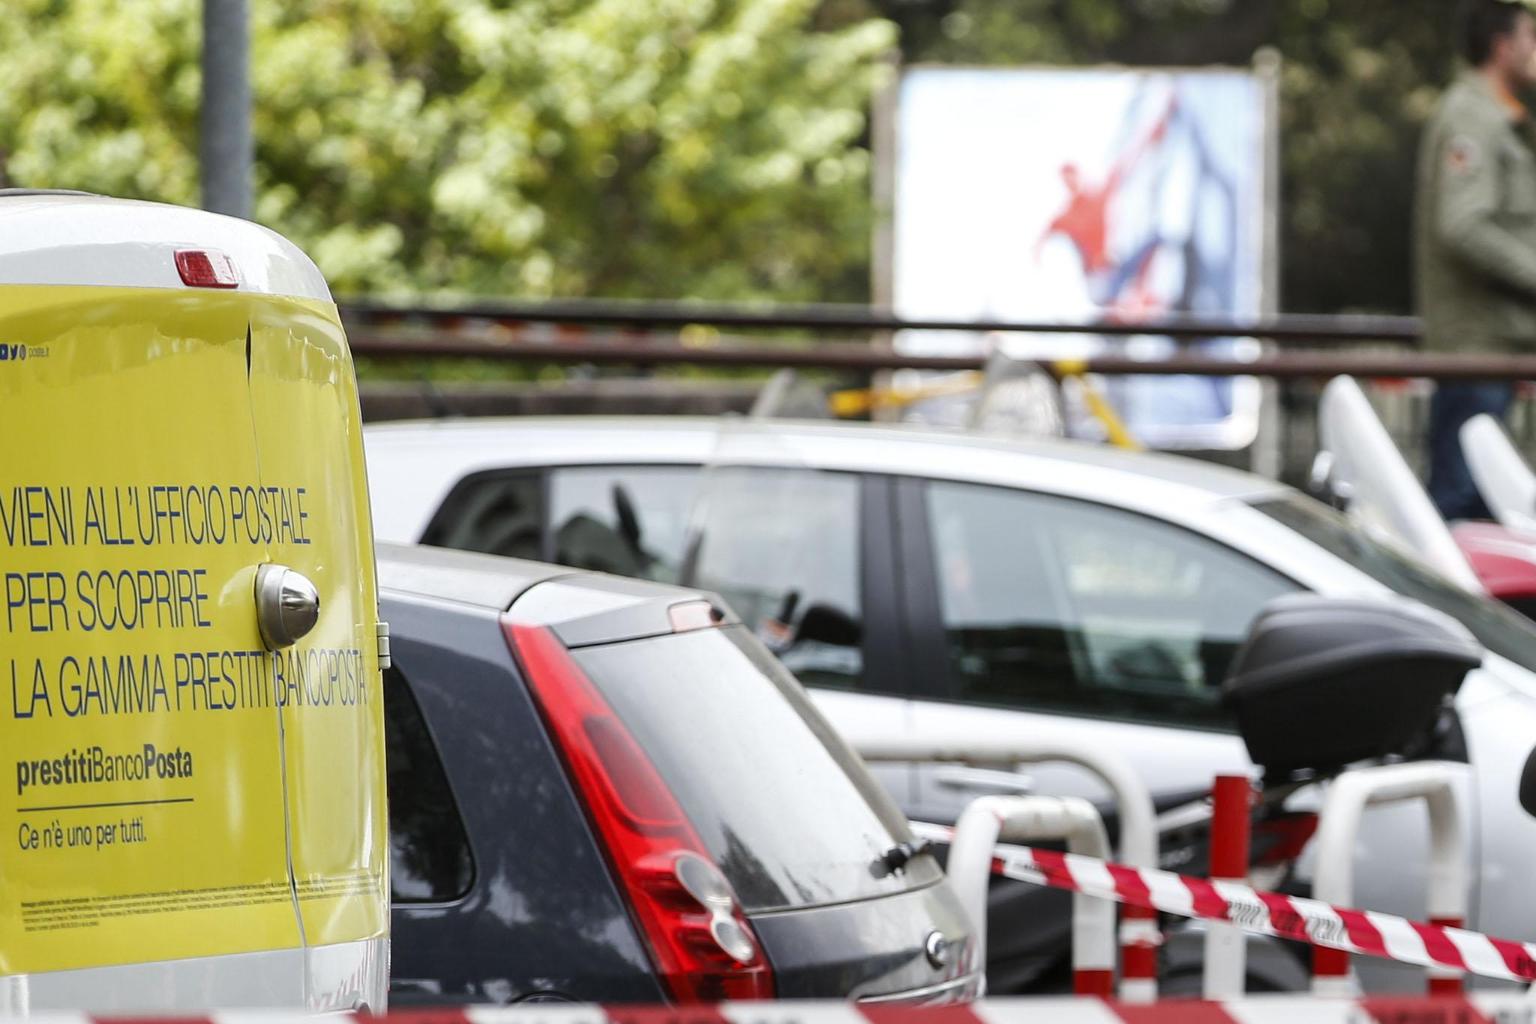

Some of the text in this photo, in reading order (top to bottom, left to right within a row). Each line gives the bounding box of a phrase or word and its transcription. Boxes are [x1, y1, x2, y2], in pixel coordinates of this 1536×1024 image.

[0, 485, 311, 546] VIENI ALL'UFFICIO POSTALE
[5, 569, 211, 633] PER SCOPRIRE
[11, 648, 367, 719] LA GAMMA PRESTITI BANCOPOSTA
[17, 744, 193, 795] prestitiBancoPosta
[18, 823, 39, 850] Ce
[67, 825, 92, 848] uno
[96, 823, 117, 851] per
[121, 817, 147, 843] tutti.
